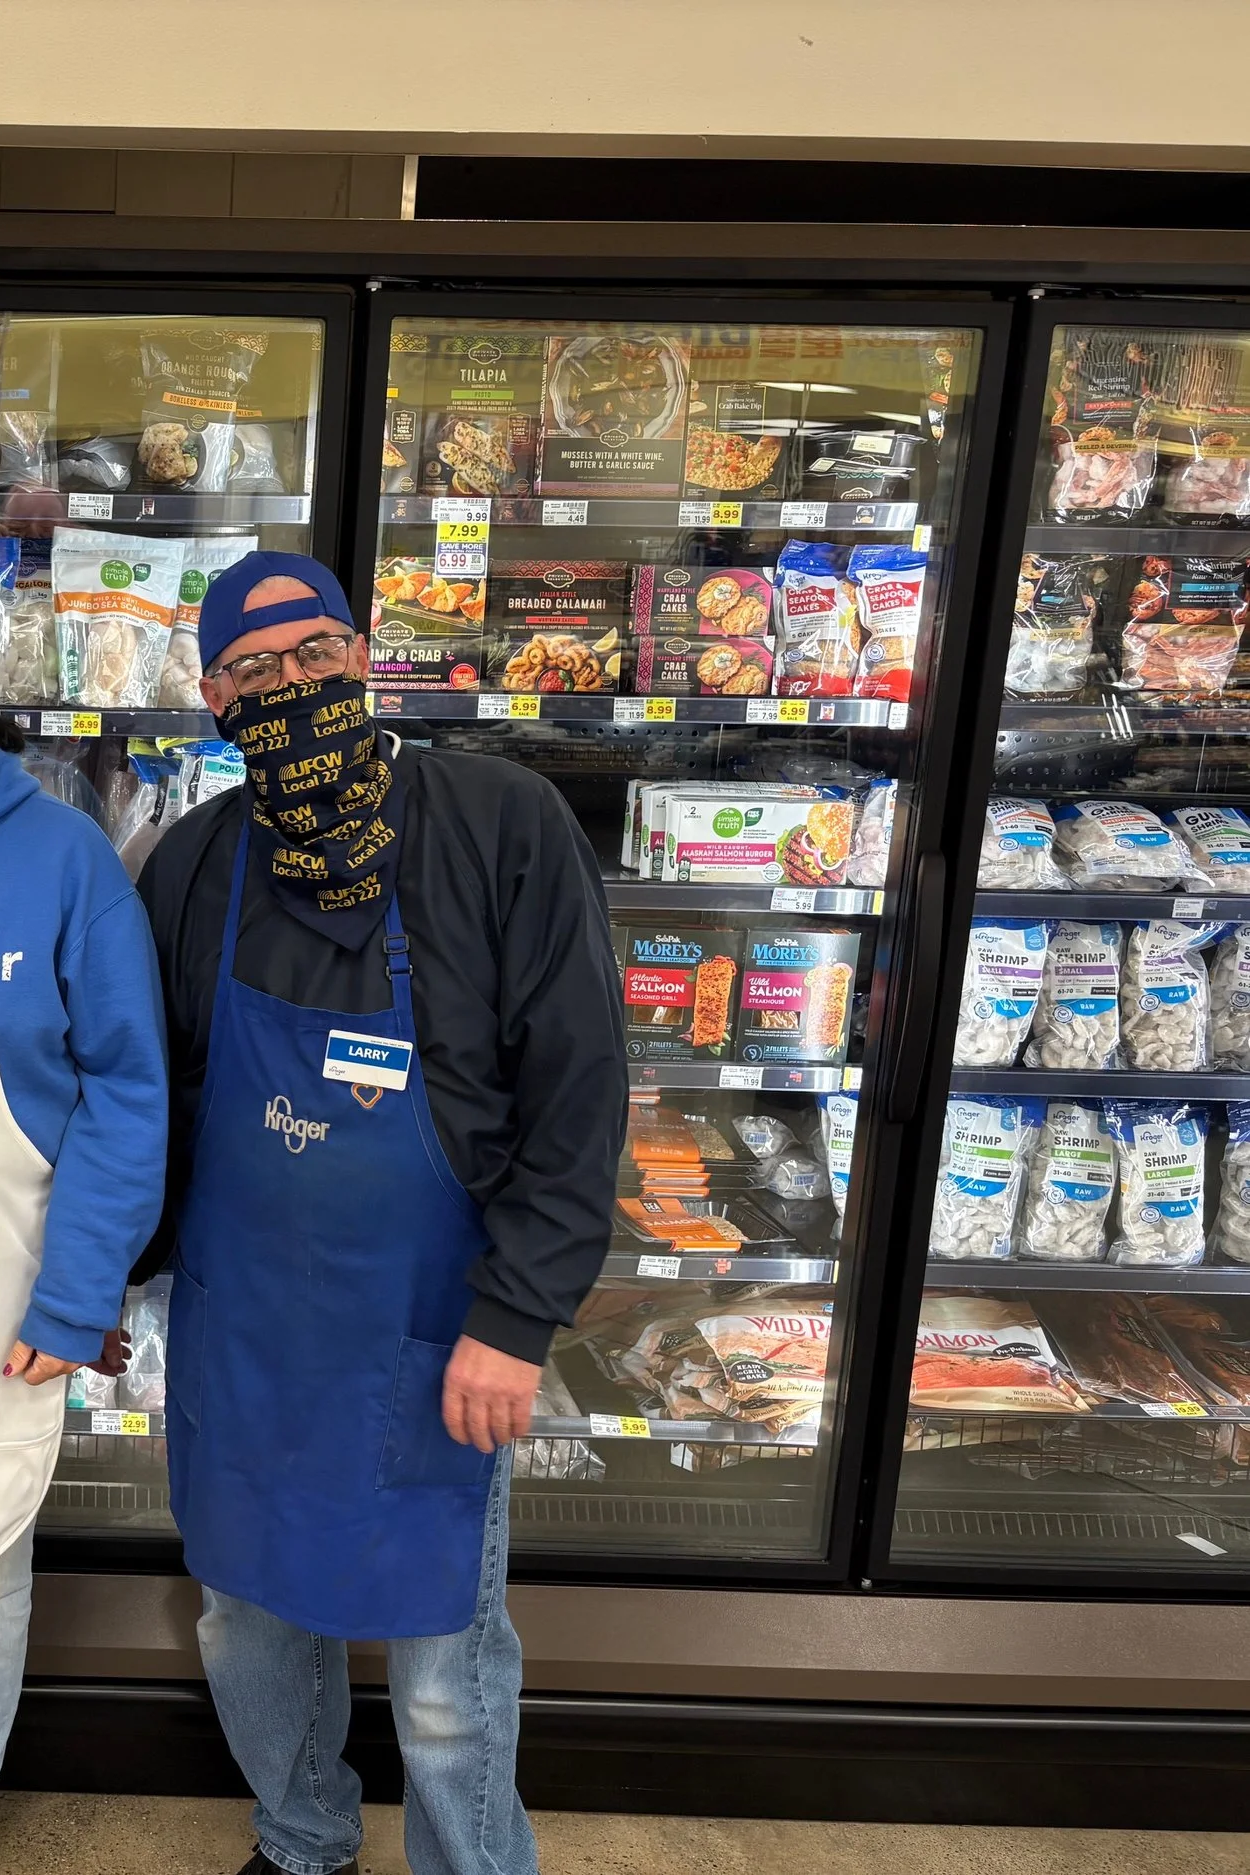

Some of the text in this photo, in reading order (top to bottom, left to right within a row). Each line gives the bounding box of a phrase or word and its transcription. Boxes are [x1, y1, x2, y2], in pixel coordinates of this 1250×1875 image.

[161, 362, 202, 376] ORANGE
[460, 369, 507, 382] TILAPIA
[1104, 383, 1130, 392] Shrimp
[170, 395, 233, 410] BONELESS SKINLESS
[719, 402, 733, 410] Crab
[751, 403, 762, 412] Dip
[561, 451, 643, 460] MUSSELS WITH WHITE
[93, 508, 110, 517] 11.99
[466, 512, 487, 521] 9.99
[713, 510, 739, 519] 8.99
[568, 514, 585, 523] 4.49
[806, 516, 824, 525] 7.99
[449, 525, 478, 537] 7.99
[439, 554, 466, 567] 6.99
[106, 572, 128, 582] truth
[182, 586, 203, 594] truth
[867, 585, 893, 594] CRAB
[508, 598, 606, 609] BREADED CALAMARI
[664, 594, 686, 603] CRAB
[68, 600, 99, 610] JUMBO
[120, 602, 161, 620] SCALLOPS
[661, 604, 687, 612] CAKES
[790, 603, 820, 613] CAKES
[872, 601, 900, 611] CAKES
[396, 649, 442, 662] & CRAB
[374, 663, 412, 672] RANGOON
[664, 662, 686, 671] CRAB
[661, 671, 688, 680] CAKES
[260, 682, 324, 706] Local 227
[494, 708, 509, 716] 7.99
[512, 703, 537, 712] 6.99
[646, 706, 672, 714] 8.99
[780, 707, 805, 716] 6.99
[628, 711, 644, 720] 11.99
[74, 720, 98, 729] 26.99
[313, 712, 363, 738] Local 227
[267, 734, 291, 751] 227
[281, 774, 319, 794] Local
[346, 828, 396, 869] Local 227
[272, 861, 329, 880] Local 227
[319, 884, 381, 911] Local 227
[795, 902, 812, 910] 5.99
[1154, 925, 1180, 940] Kroger
[632, 940, 702, 957] MOREY'S
[752, 944, 820, 960] MOREY'S
[979, 953, 1028, 965] SHRIMP
[1057, 953, 1106, 963] SHRIMP
[630, 973, 662, 982] Atlantic
[748, 978, 770, 986] Wild
[631, 982, 685, 993] SALMON
[749, 986, 802, 997] SALMON
[348, 1046, 390, 1062] LARRY
[1053, 1110, 1080, 1124] Kroger
[264, 1095, 330, 1154] Kroger
[954, 1130, 1002, 1146] SHRIMP
[1140, 1131, 1163, 1144] Kroger
[1054, 1137, 1100, 1149] SHRIMP
[1055, 1150, 1081, 1158] LARGE
[1146, 1154, 1188, 1168] SHRIMP
[643, 1219, 703, 1227] SALMON
[742, 1316, 805, 1336] WILD
[122, 1420, 146, 1429] 22.99
[622, 1423, 647, 1432] 5.99
